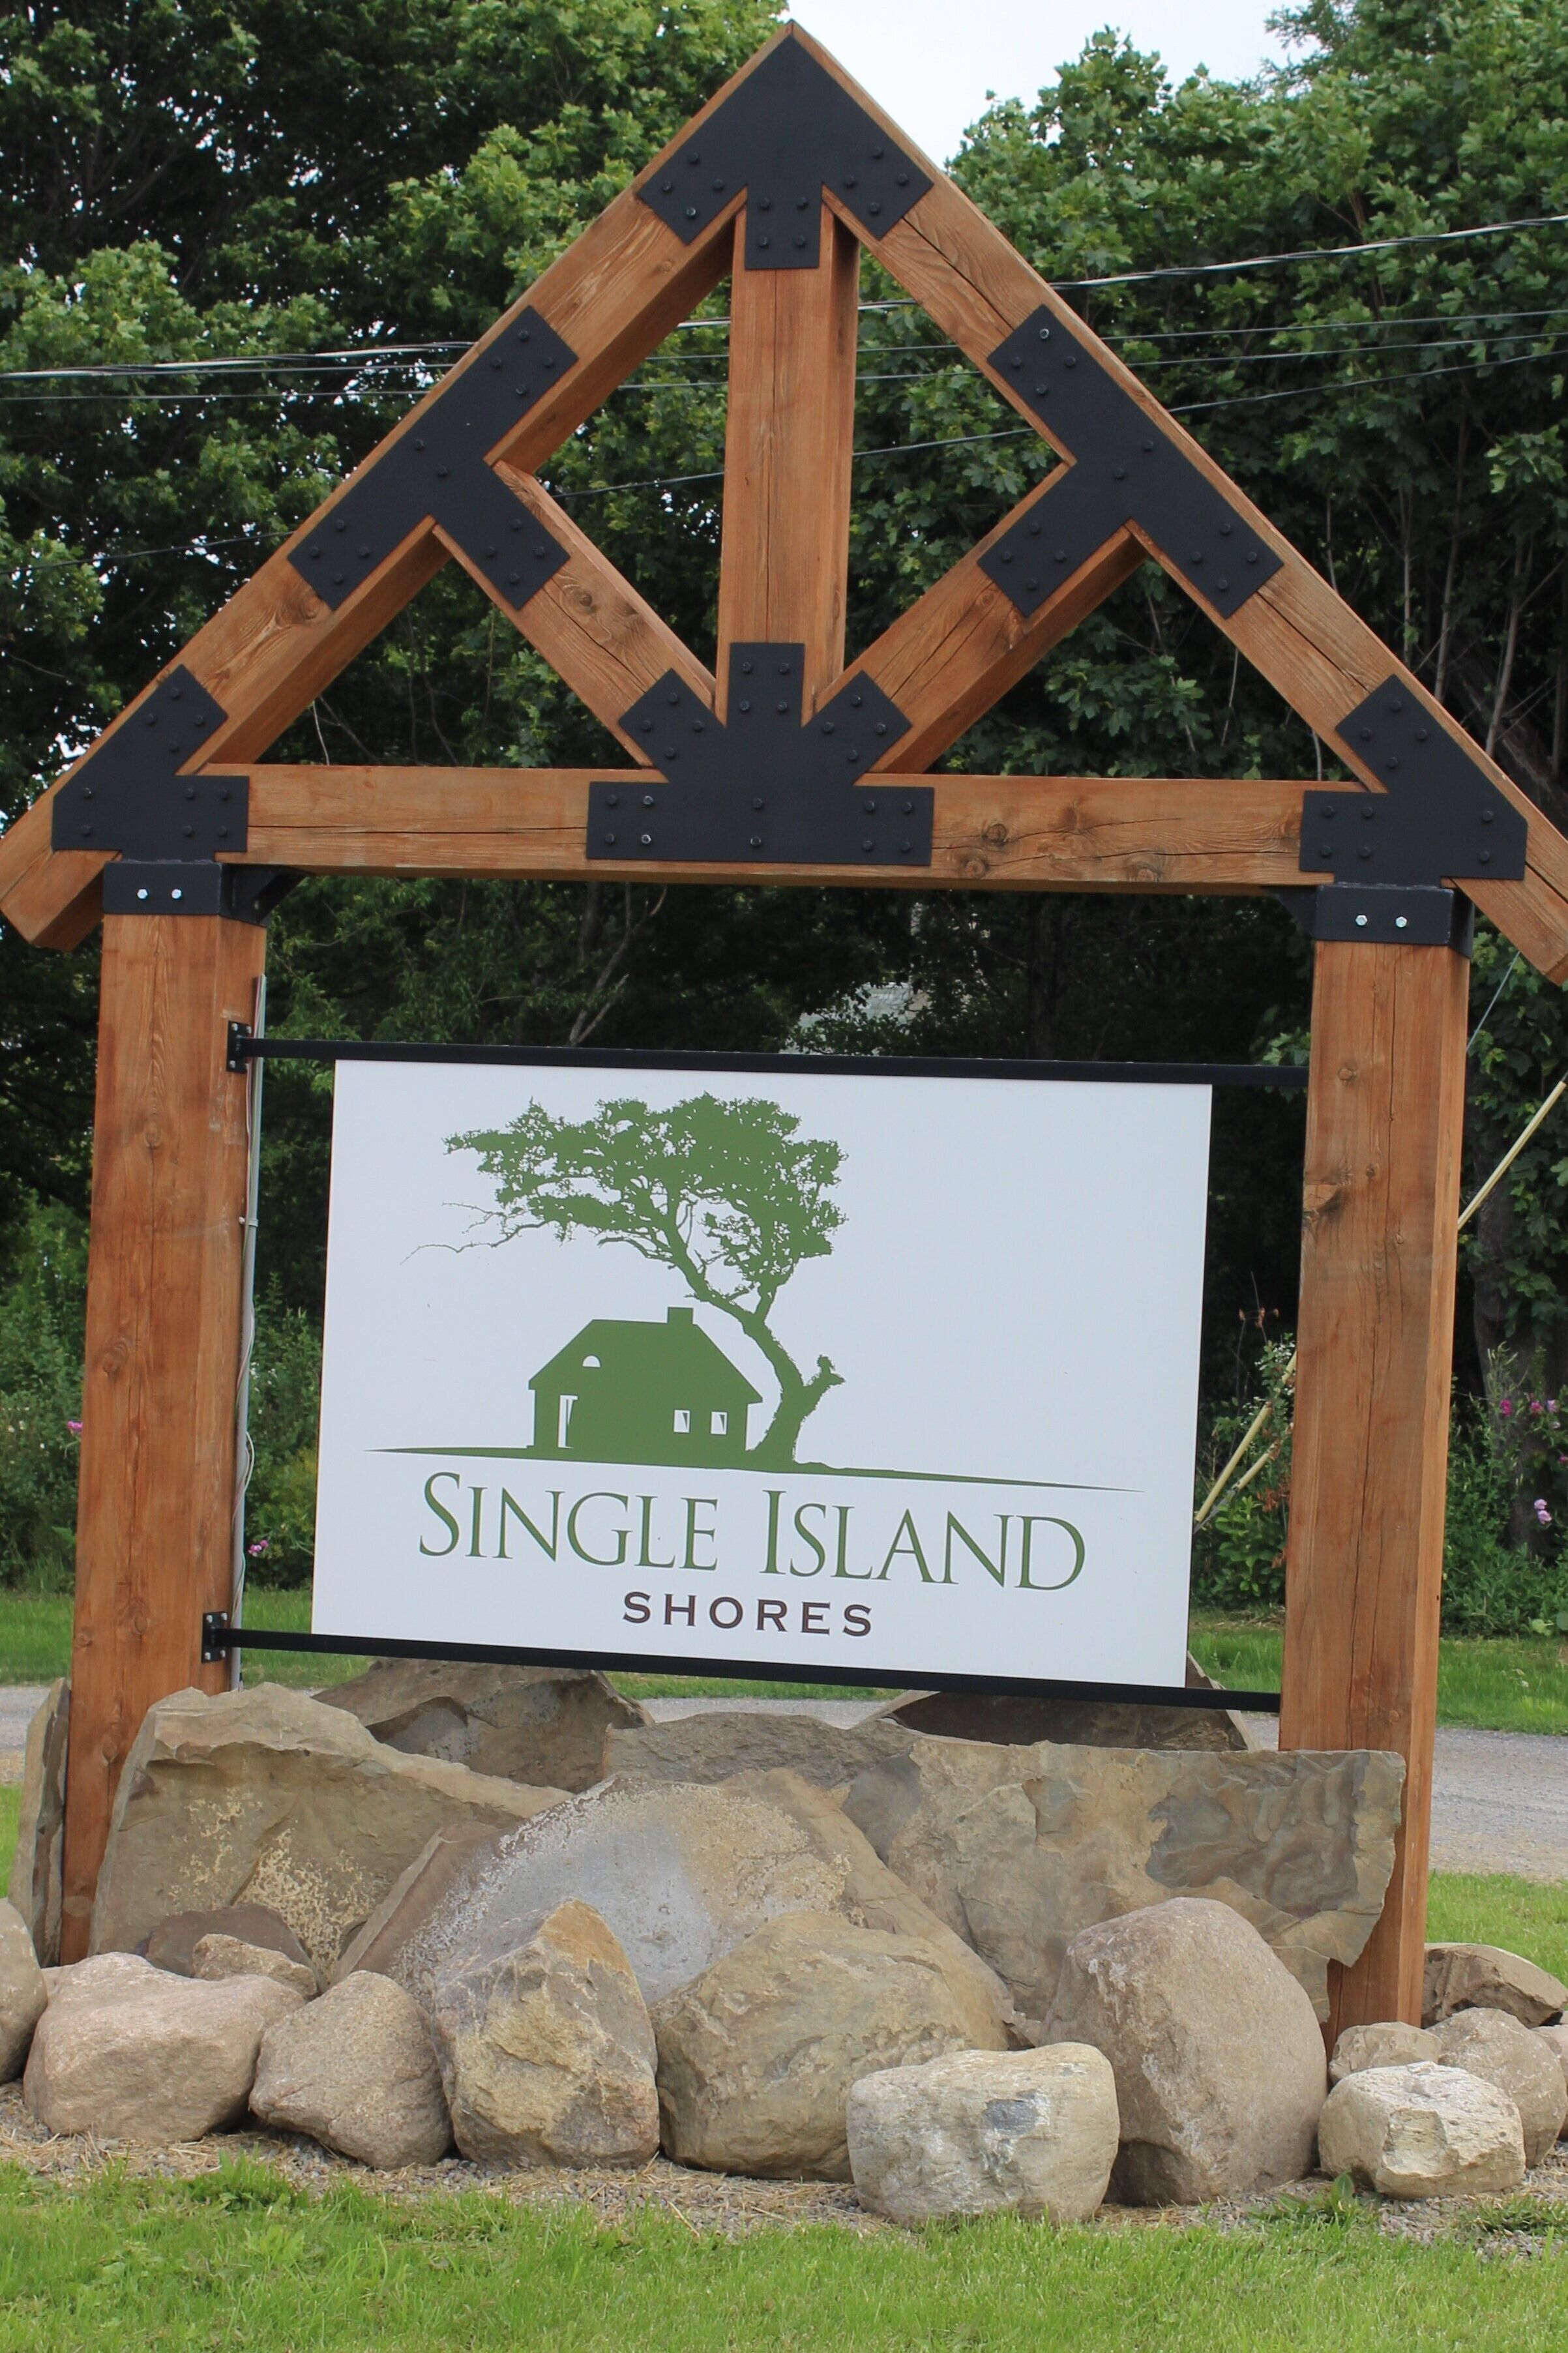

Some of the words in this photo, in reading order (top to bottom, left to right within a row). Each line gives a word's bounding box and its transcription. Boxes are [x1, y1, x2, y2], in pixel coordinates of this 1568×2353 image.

[419, 1472, 718, 1571] SINGLE
[759, 1490, 1086, 1591] ISLAND
[622, 1591, 872, 1637] SHORES
